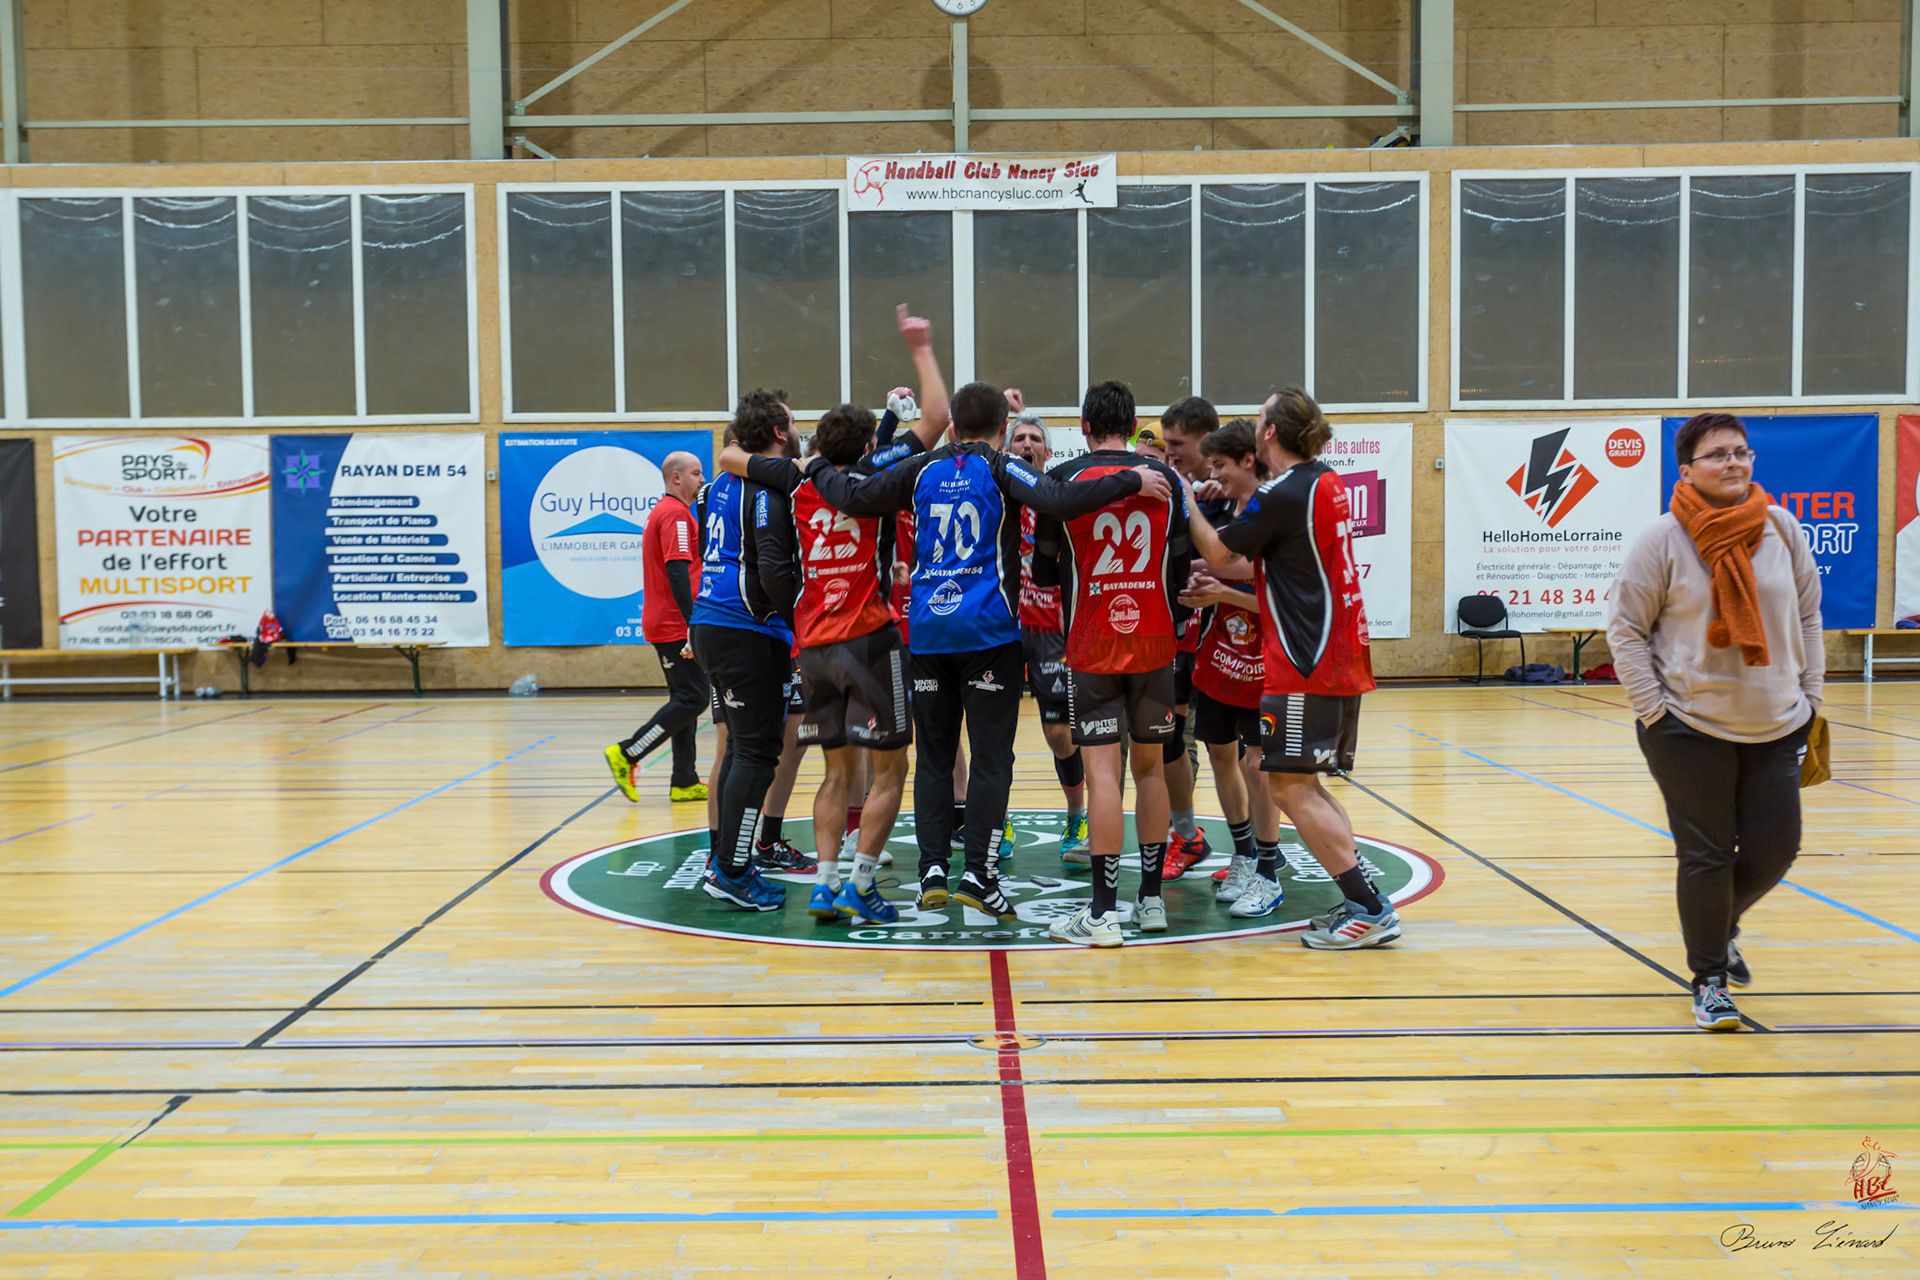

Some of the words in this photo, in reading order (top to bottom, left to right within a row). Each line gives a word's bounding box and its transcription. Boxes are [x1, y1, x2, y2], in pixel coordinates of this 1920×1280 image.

[885, 161, 956, 180] Handball
[964, 162, 1001, 179] Club
[1007, 164, 1056, 183] Nancy
[1063, 161, 1099, 179] Sluc
[906, 187, 1063, 202] www.hbcnancysluc.com
[1334, 438, 1348, 454] les
[1350, 437, 1380, 454] autres
[1608, 438, 1642, 450] DEVIS
[1608, 449, 1642, 458] GRATUIT
[121, 455, 173, 468] PAYS
[341, 465, 398, 477] RAYAN
[402, 465, 441, 477] DEM
[447, 465, 467, 477] 54
[331, 497, 413, 508] Déménagement
[540, 492, 583, 516] Guy
[590, 492, 665, 515] Hoque
[129, 505, 198, 523] Votre
[331, 516, 384, 527] Transport
[385, 516, 400, 526] de
[401, 516, 431, 526] Piano
[78, 529, 252, 547] PARTENAIRE
[930, 501, 980, 564] 70
[1483, 529, 1622, 543] HelloHomeLorraine
[332, 536, 362, 545] Vente
[365, 536, 379, 545] de
[381, 535, 430, 545] Matériels
[541, 541, 617, 551] L'IMMOBILIER
[1092, 510, 1151, 576] 29
[1497, 545, 1535, 553] solution
[1539, 546, 1562, 554] pour
[1592, 544, 1621, 554] projet
[103, 554, 132, 571] de
[141, 553, 228, 571] l'effort
[333, 554, 379, 564] Location
[381, 554, 395, 563] de
[396, 554, 436, 564] Camion
[1517, 562, 1551, 572] générale
[1558, 561, 1602, 571] Dépannage
[334, 573, 388, 582] Particulier
[396, 573, 451, 583] Entreprise
[1486, 572, 1531, 580] Rénovation
[1537, 571, 1578, 581] Diagnostic
[79, 576, 253, 595] MULTISPORT
[333, 592, 379, 601] Location
[381, 592, 461, 601] Monte-meubles
[1508, 590, 1532, 605] 21
[1540, 589, 1564, 604] 48
[1571, 588, 1596, 604] 34
[356, 616, 368, 624] 06
[373, 616, 386, 624] 16
[407, 616, 420, 624] 45
[424, 616, 438, 624] 34
[1508, 609, 1603, 619] ellohomelor@gmail.com
[353, 628, 366, 636] 03
[370, 628, 383, 636] 54
[388, 628, 400, 636] 16
[405, 628, 418, 636] 75
[422, 628, 435, 636] 22
[616, 626, 631, 637] 03
[847, 927, 1139, 941] Carrefr
